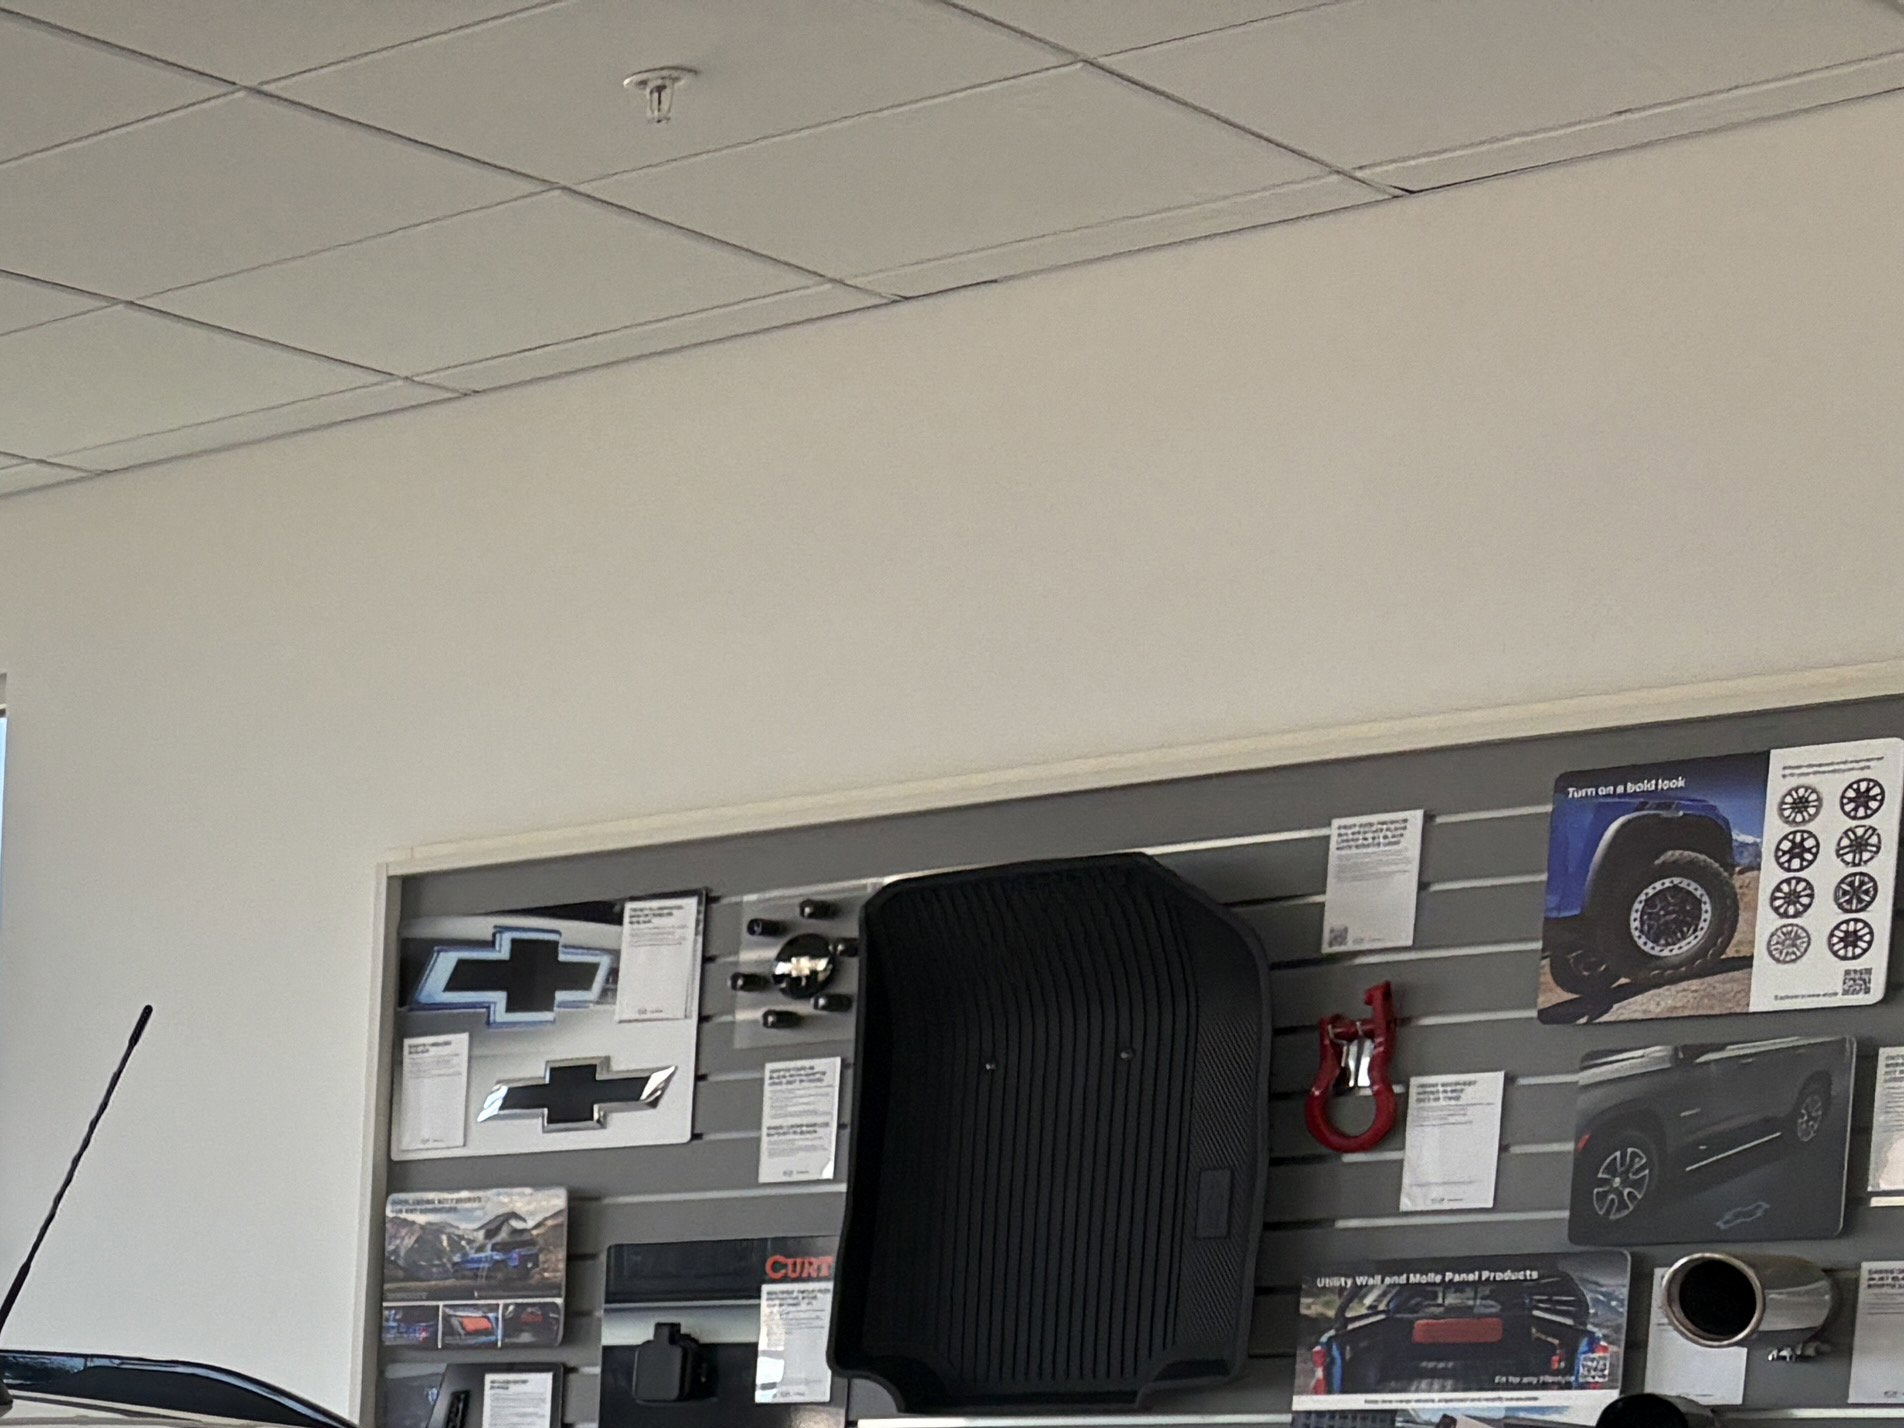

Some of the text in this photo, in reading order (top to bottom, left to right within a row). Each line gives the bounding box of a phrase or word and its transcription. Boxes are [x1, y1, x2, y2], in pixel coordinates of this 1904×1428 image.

[1567, 787, 1596, 799] Turn
[1598, 785, 1614, 796] on
[1626, 779, 1656, 793] bold
[1657, 776, 1685, 791] look
[765, 1254, 834, 1281] CURT
[1316, 1276, 1353, 1289] Utility
[1355, 1275, 1382, 1287] Wall
[1383, 1273, 1407, 1285] and
[1444, 1271, 1479, 1283] Panel
[1481, 1269, 1539, 1281] Products
